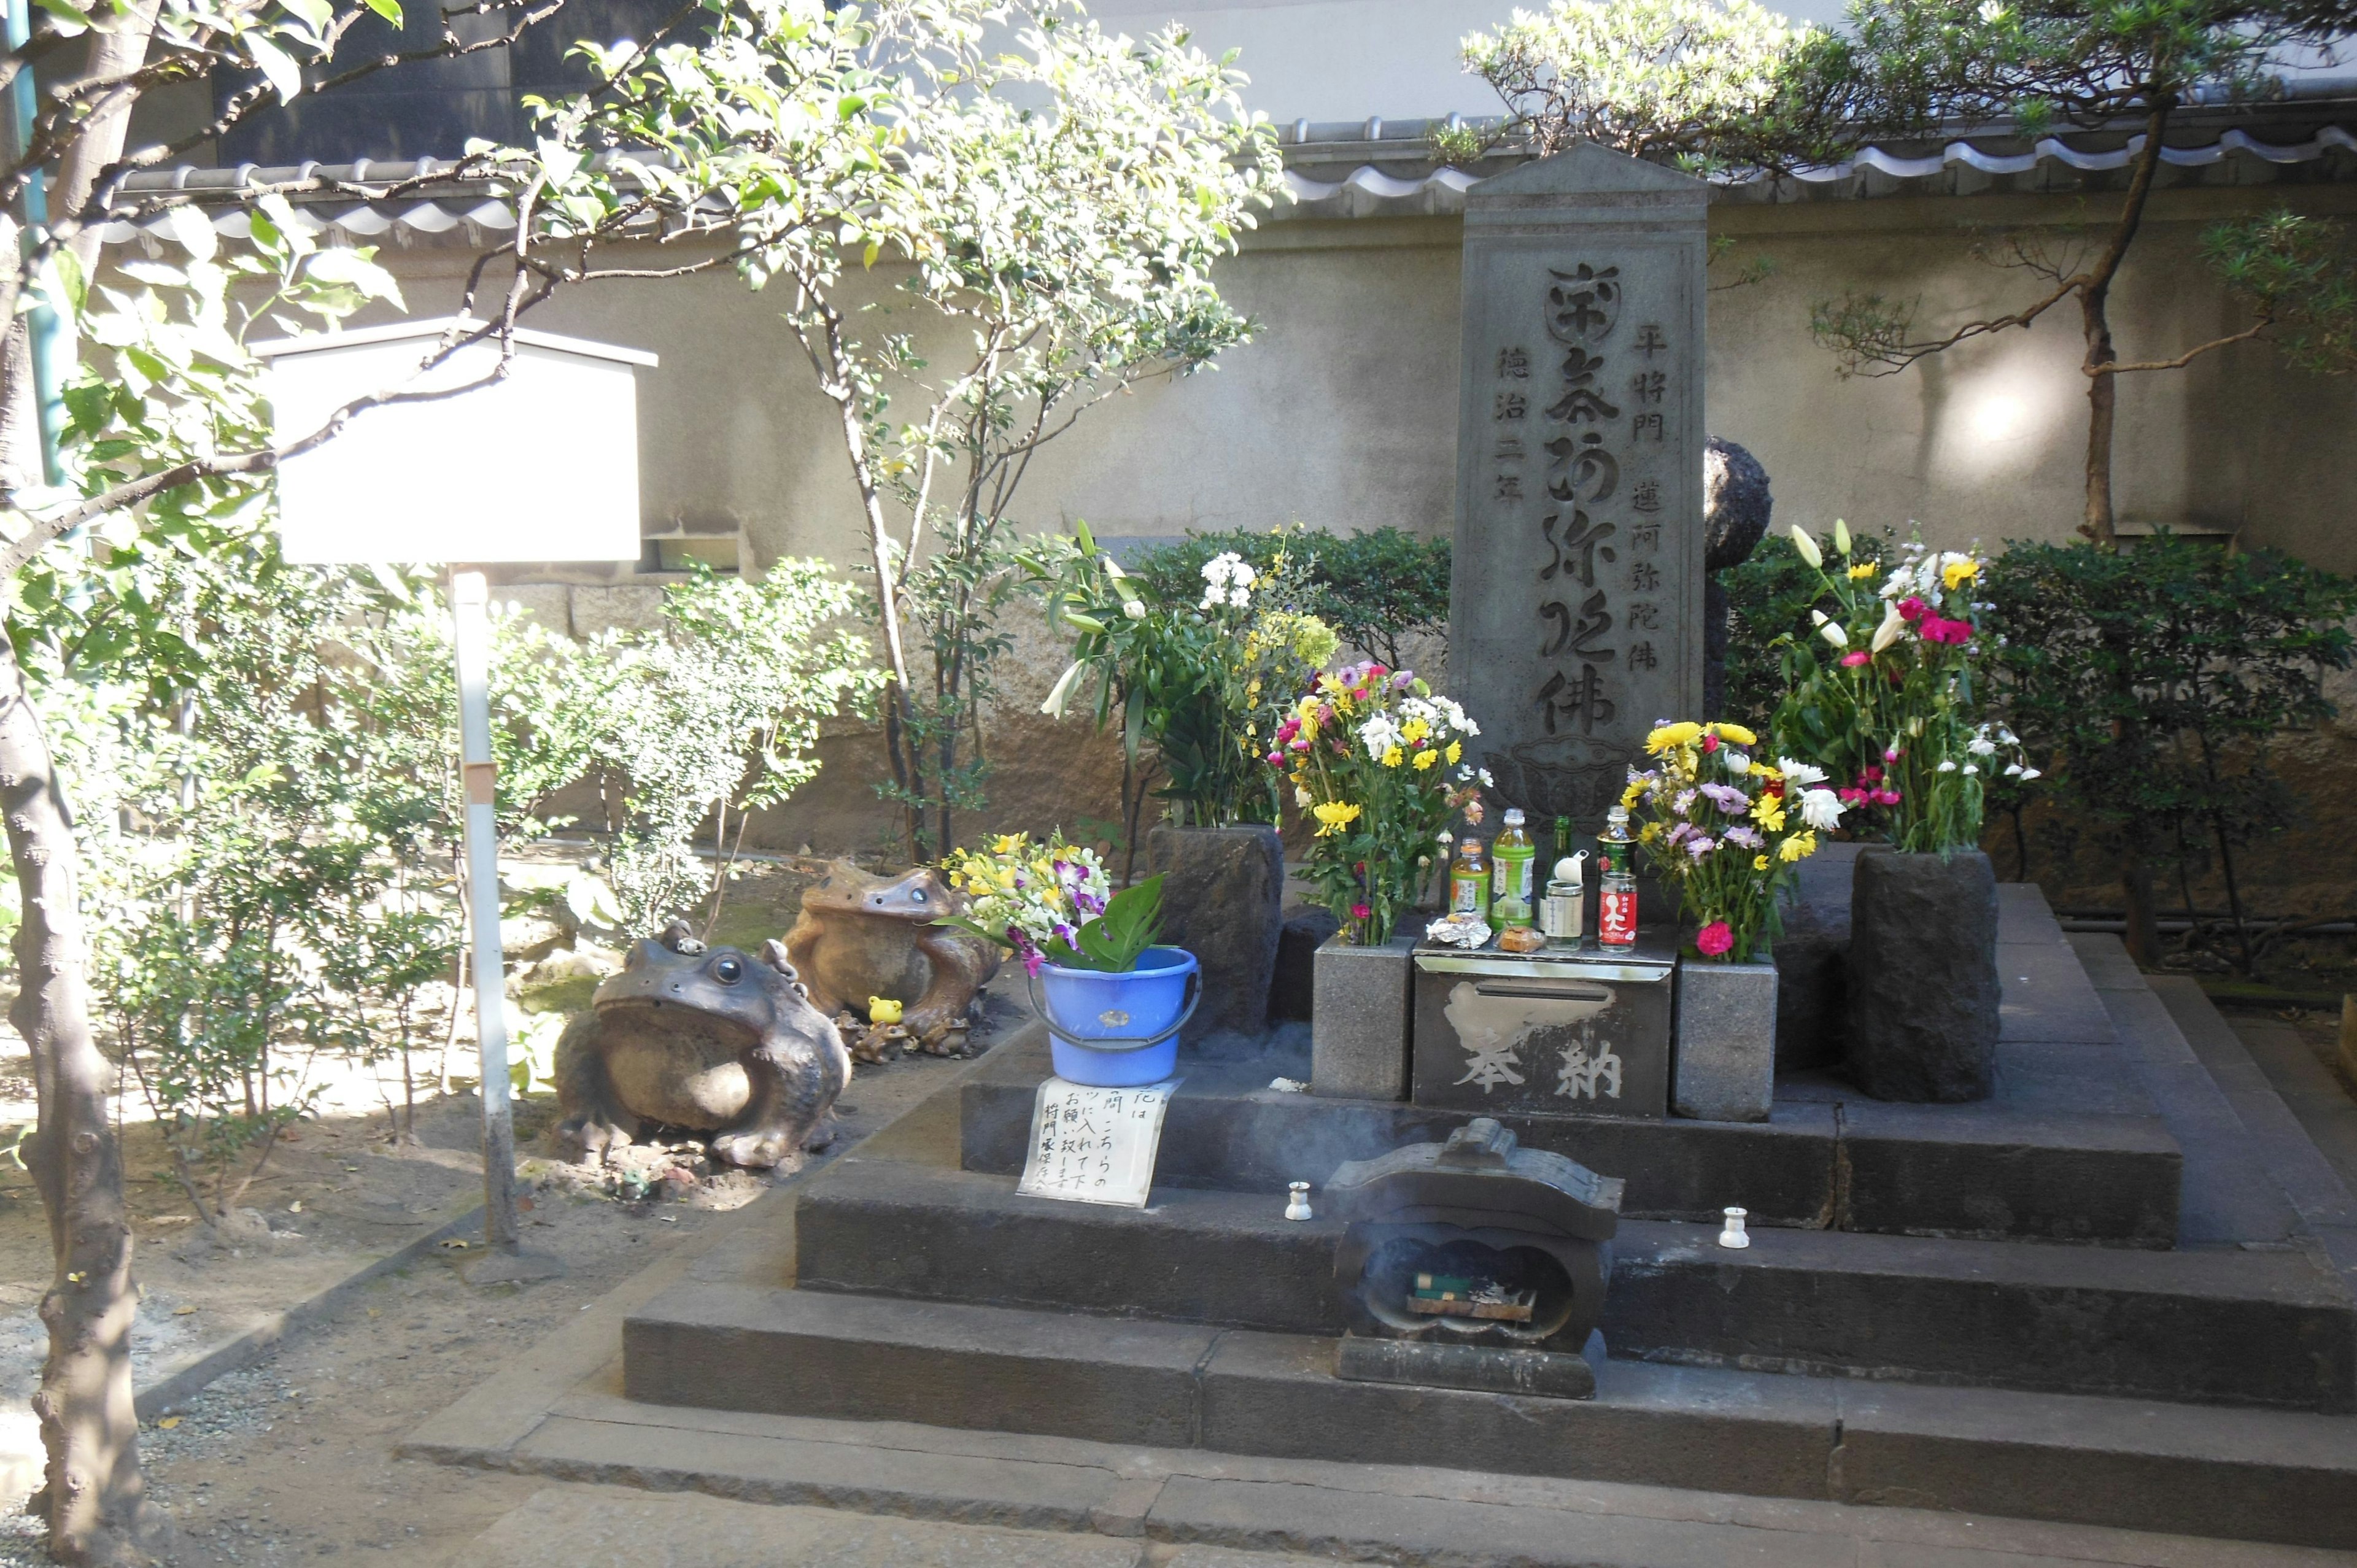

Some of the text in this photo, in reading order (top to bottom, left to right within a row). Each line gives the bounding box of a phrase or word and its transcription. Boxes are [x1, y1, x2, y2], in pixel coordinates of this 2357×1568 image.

[1453, 1027, 1622, 1099] 奉納
[1048, 1092, 1079, 1191] お願い致します
[1070, 1091, 1099, 1189] ツに入れて下
